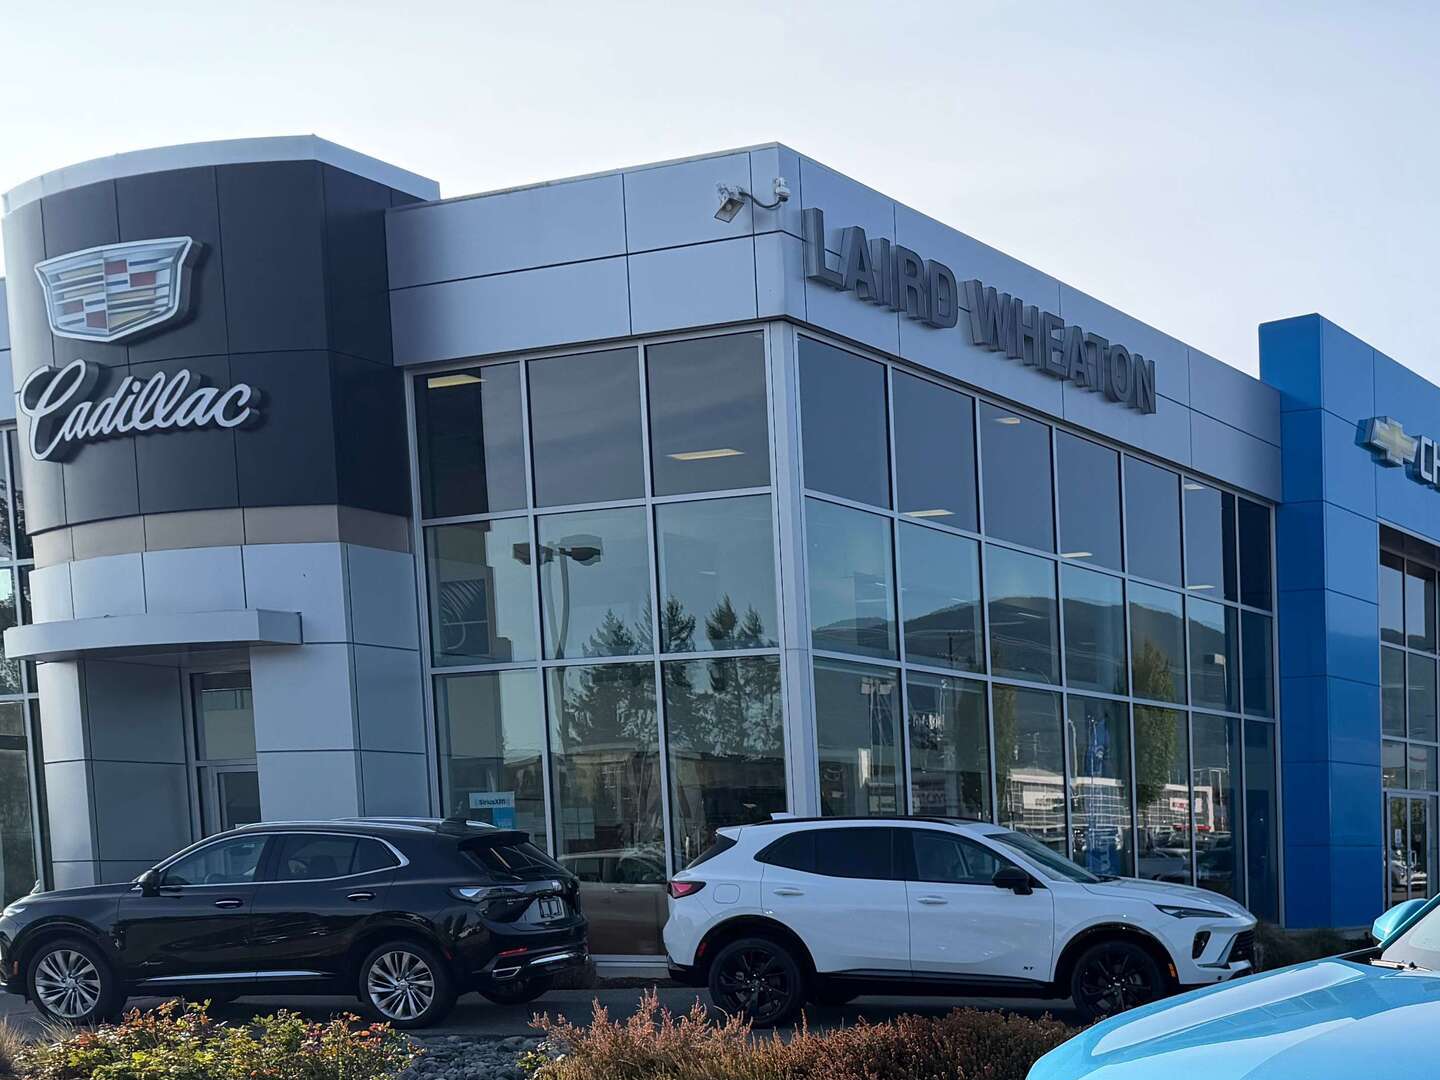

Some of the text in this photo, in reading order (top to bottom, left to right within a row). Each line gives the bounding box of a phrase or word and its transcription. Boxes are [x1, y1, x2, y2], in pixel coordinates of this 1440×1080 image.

[803, 207, 1157, 415] LAIRD WHEATON
[19, 358, 253, 461] Cadillac
